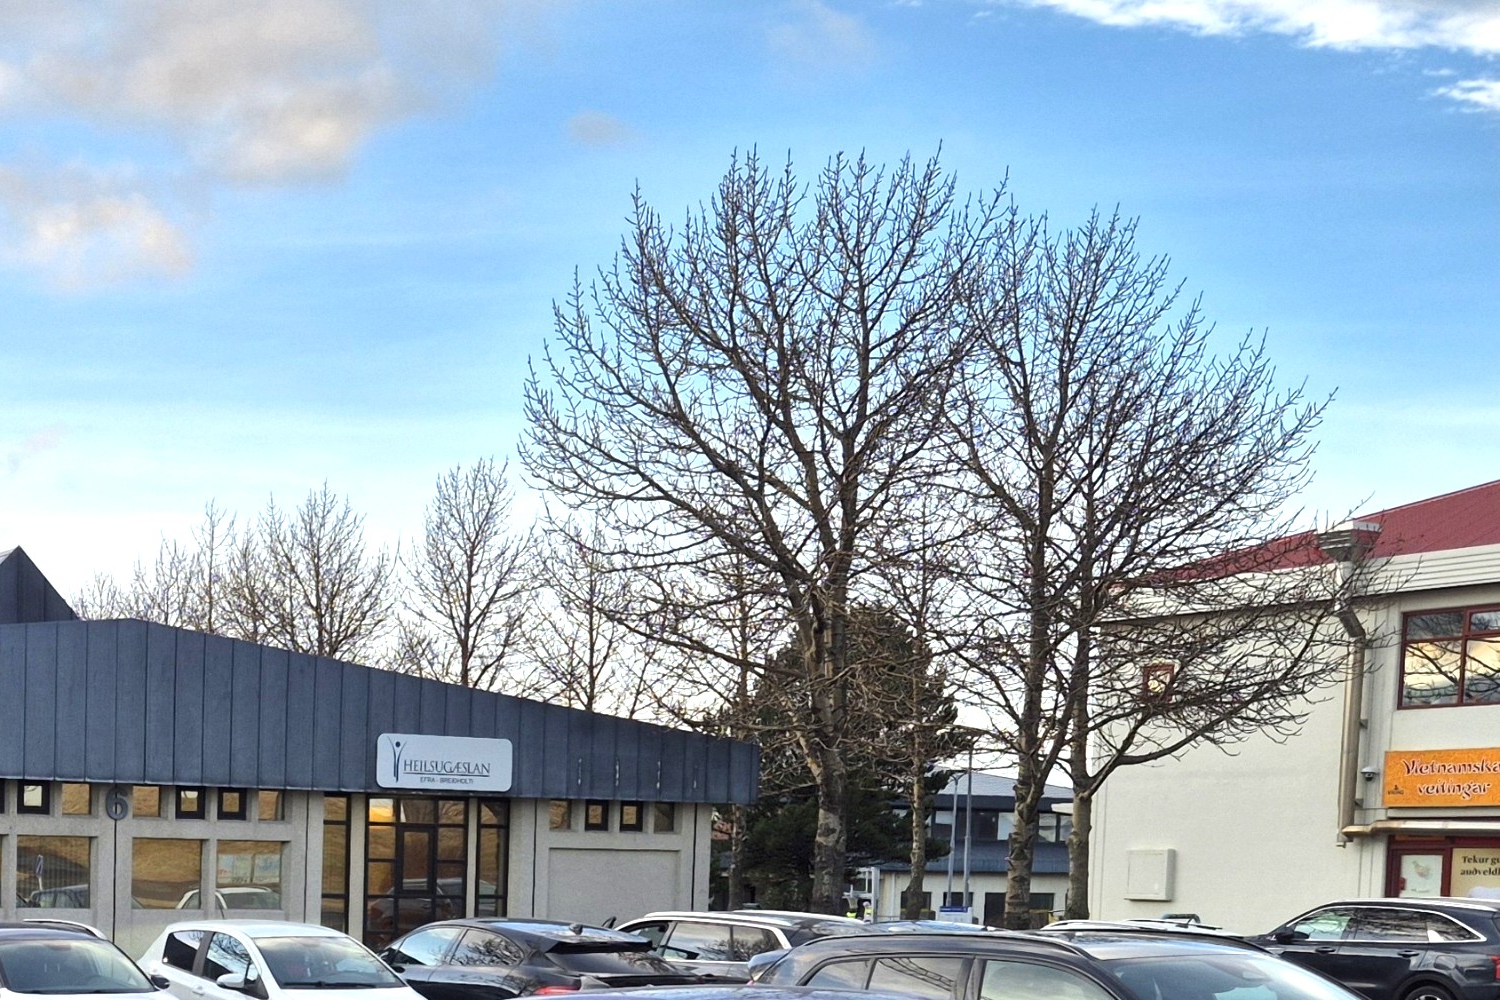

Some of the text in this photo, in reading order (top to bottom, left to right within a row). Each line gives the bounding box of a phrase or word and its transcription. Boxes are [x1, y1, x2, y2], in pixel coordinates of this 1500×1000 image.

[404, 759, 491, 774] HEILSUGÆSLAN
[1417, 780, 1491, 800] veitingar
[106, 786, 128, 820] 6
[1462, 855, 1489, 864] Tekur
